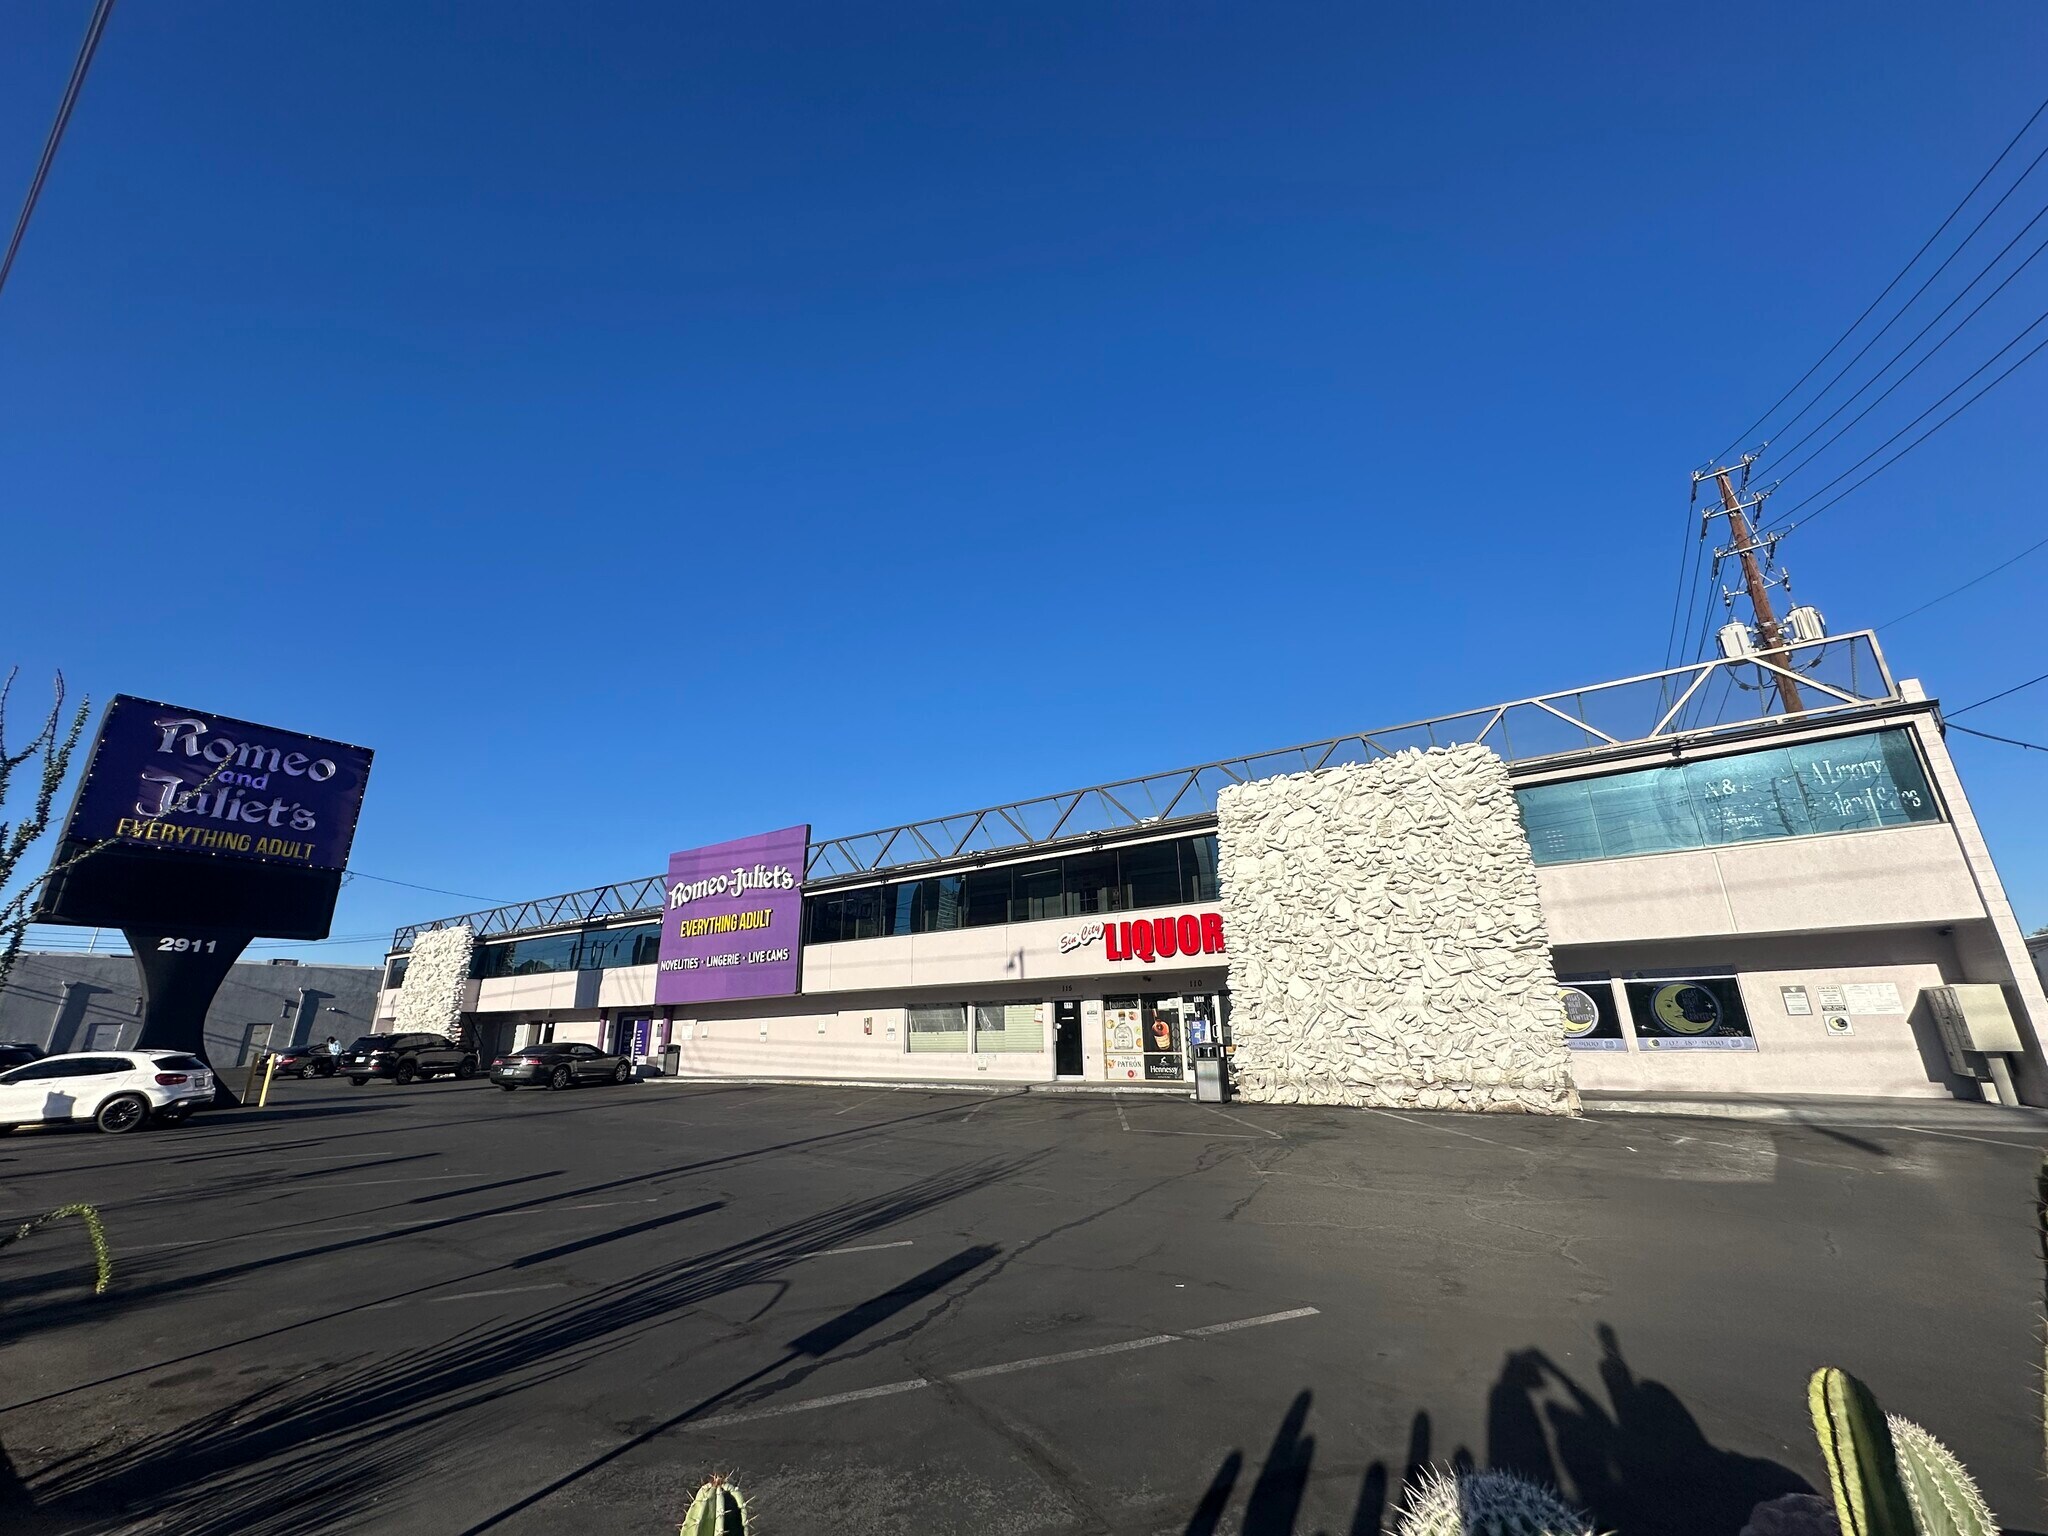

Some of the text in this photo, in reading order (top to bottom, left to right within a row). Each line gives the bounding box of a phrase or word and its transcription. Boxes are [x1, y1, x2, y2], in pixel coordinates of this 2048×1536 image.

[154, 718, 336, 782] Romeo
[217, 770, 271, 791] and
[136, 772, 316, 831] Juliet's
[116, 817, 315, 861] EVERYTHING ADULT
[668, 864, 795, 910] Romeo Juliet's
[680, 909, 773, 938] EVERYTHING ADULT
[157, 936, 216, 953] 2911
[1060, 912, 1226, 963] Sin City LIQUOR
[706, 953, 741, 968] LINGERIE
[748, 950, 766, 964] LIVE
[766, 948, 789, 961] CAMS
[1062, 984, 1073, 992] 115
[1190, 979, 1203, 987] 110
[1150, 1065, 1178, 1075] Hennessy
